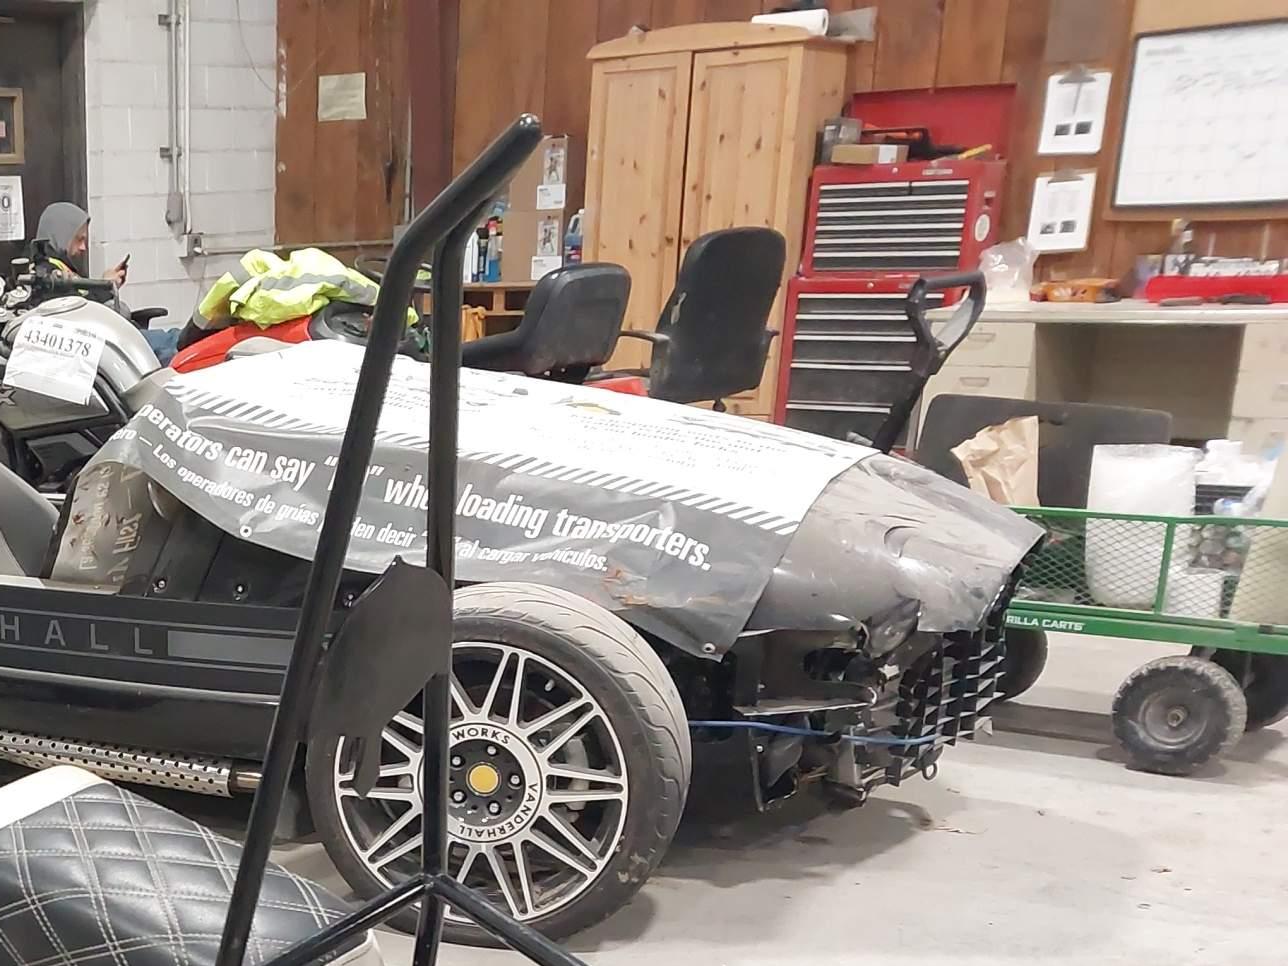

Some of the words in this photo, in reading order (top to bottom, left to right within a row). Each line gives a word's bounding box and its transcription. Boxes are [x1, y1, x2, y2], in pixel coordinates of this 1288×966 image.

[23, 329, 92, 357] 43401378
[108, 427, 138, 441] ero
[152, 444, 177, 470] Los
[177, 466, 255, 507] operadores
[255, 493, 276, 514] de
[275, 503, 319, 526] grúas
[376, 522, 417, 548] decir
[477, 546, 534, 565] cargar
[131, 403, 223, 461] perators
[224, 446, 268, 475] can
[270, 455, 316, 491] say
[455, 483, 548, 539] loading
[552, 508, 712, 571] transporters.
[1006, 615, 1039, 626] RILLA
[1042, 619, 1084, 631] CARTS
[453, 728, 510, 744] WORKS
[458, 784, 537, 837] VANDERHALL
